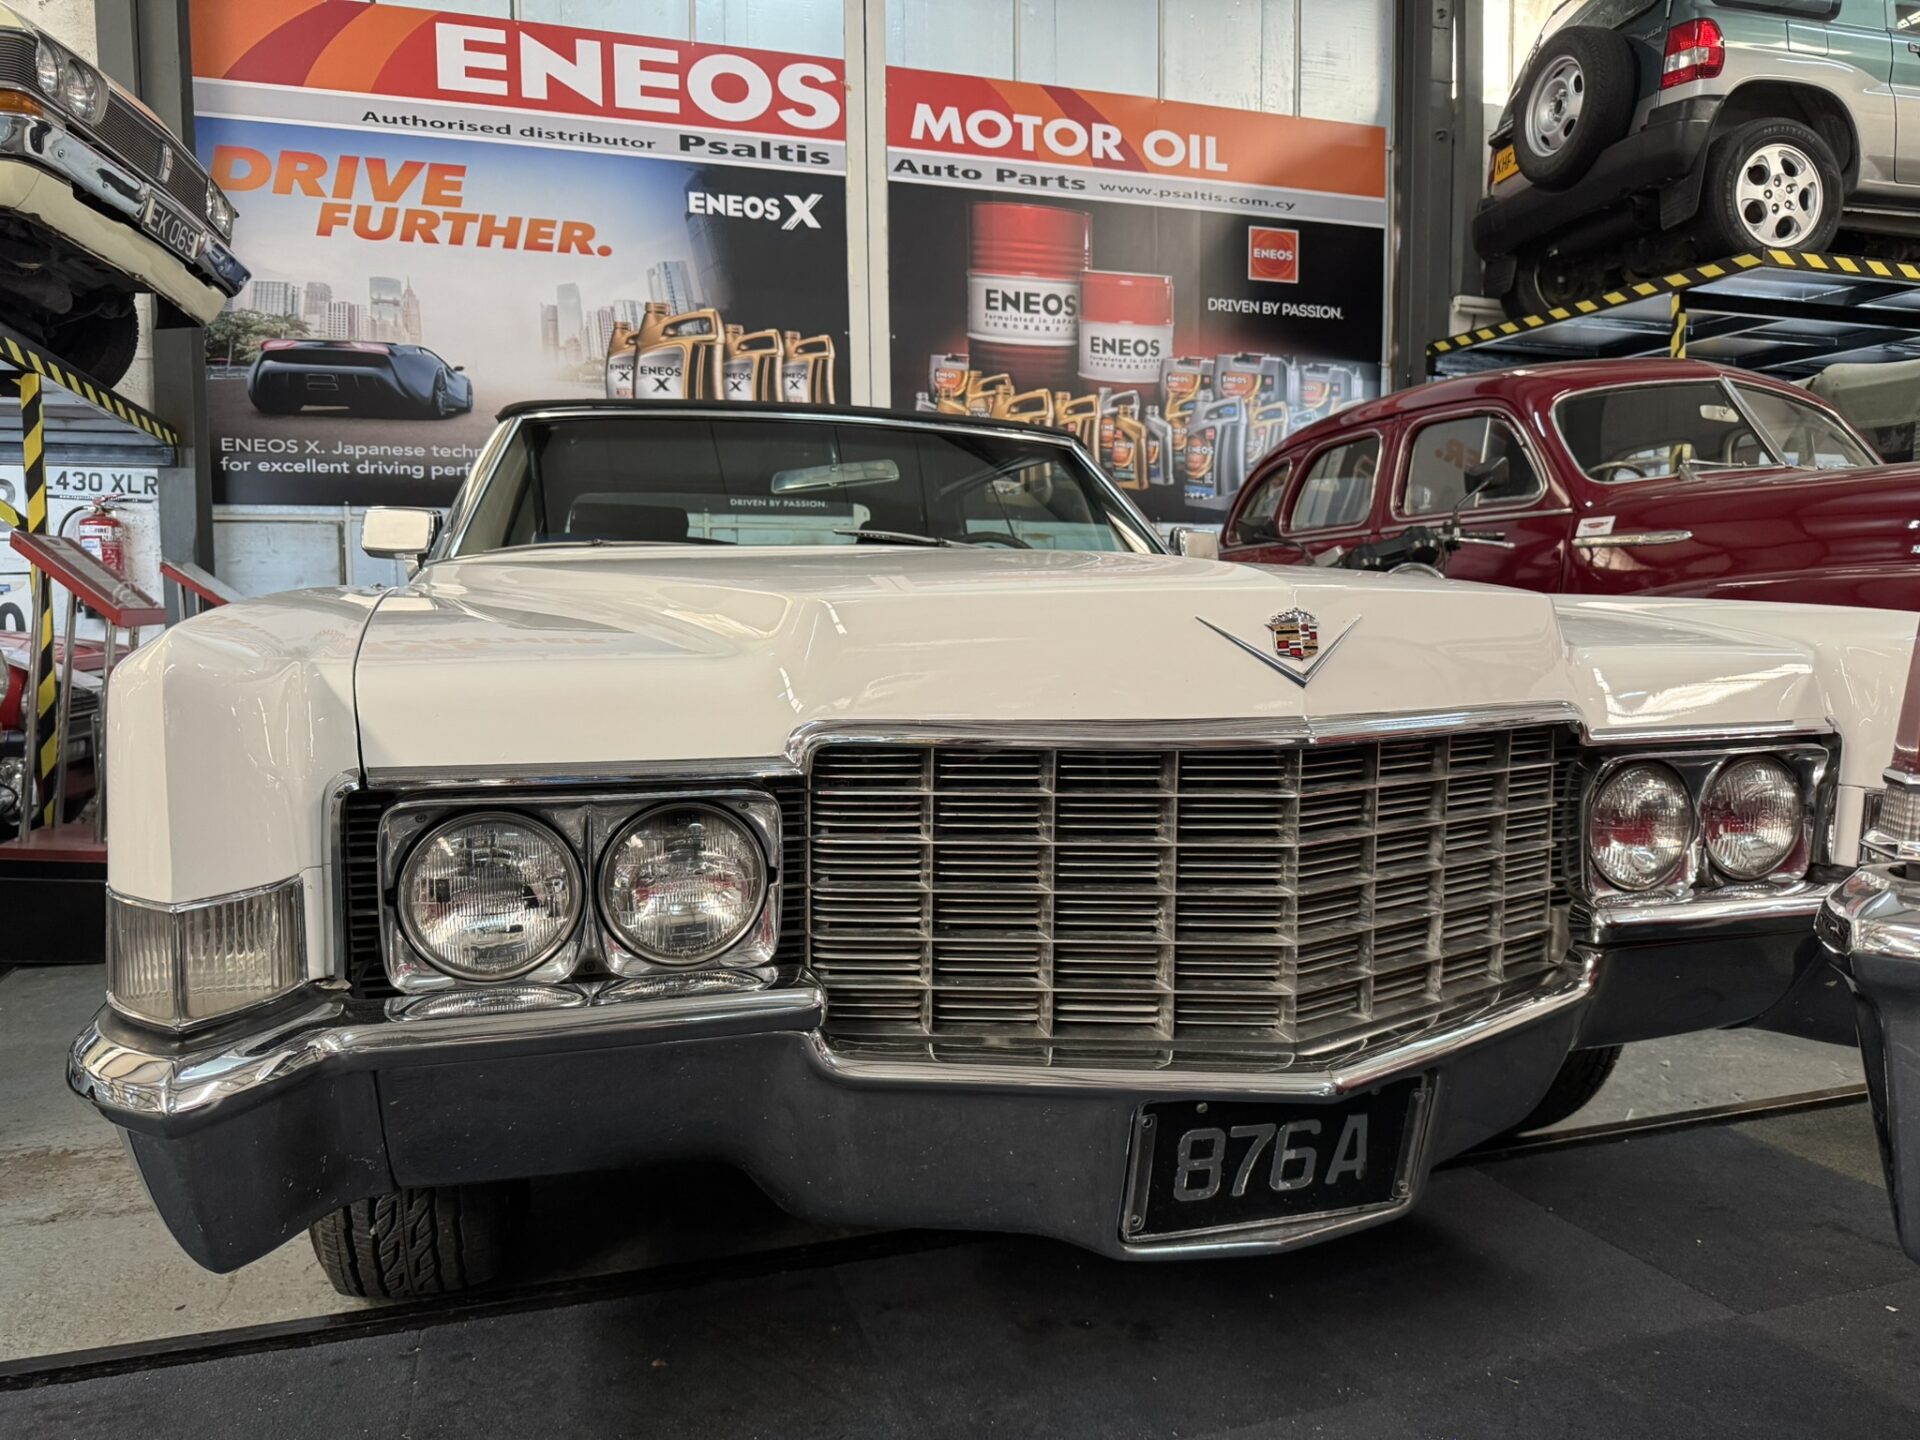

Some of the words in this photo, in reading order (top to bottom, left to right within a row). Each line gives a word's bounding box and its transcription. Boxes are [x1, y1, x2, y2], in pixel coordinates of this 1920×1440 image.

[435, 22, 841, 130] ENEOS
[361, 111, 511, 136] Authorised
[519, 124, 656, 149] distributor
[679, 134, 831, 165] Psaltis
[911, 103, 1126, 162] MOTOR
[1143, 130, 1229, 172] OIL
[210, 144, 467, 208] DRIVE
[893, 159, 983, 180] Auto
[996, 168, 1087, 191] Parts
[1100, 183, 1296, 211] www.psaltis.com.cy
[688, 191, 781, 222] ENEOS
[781, 194, 823, 231] X
[316, 202, 613, 257] FURTHER.
[1253, 248, 1294, 261] ENEOS
[985, 288, 1077, 317] ENEOS
[1207, 297, 1260, 314] DRIVEN
[1262, 301, 1280, 316] BY
[1282, 302, 1344, 320] PASSION.
[1090, 336, 1160, 357] ENEOS
[619, 371, 631, 382] X
[640, 365, 682, 377] ENEOS
[652, 377, 671, 392] X
[729, 380, 742, 392] X
[789, 380, 801, 390] X
[220, 438, 299, 454] ENEOS
[305, 439, 326, 454] X.
[332, 441, 426, 459] Japanese
[220, 457, 252, 472] for
[257, 458, 350, 474] excellent
[356, 461, 425, 480] driving
[110, 473, 159, 495] XLR
[729, 498, 767, 508] DRIVEN
[769, 499, 781, 508] BY
